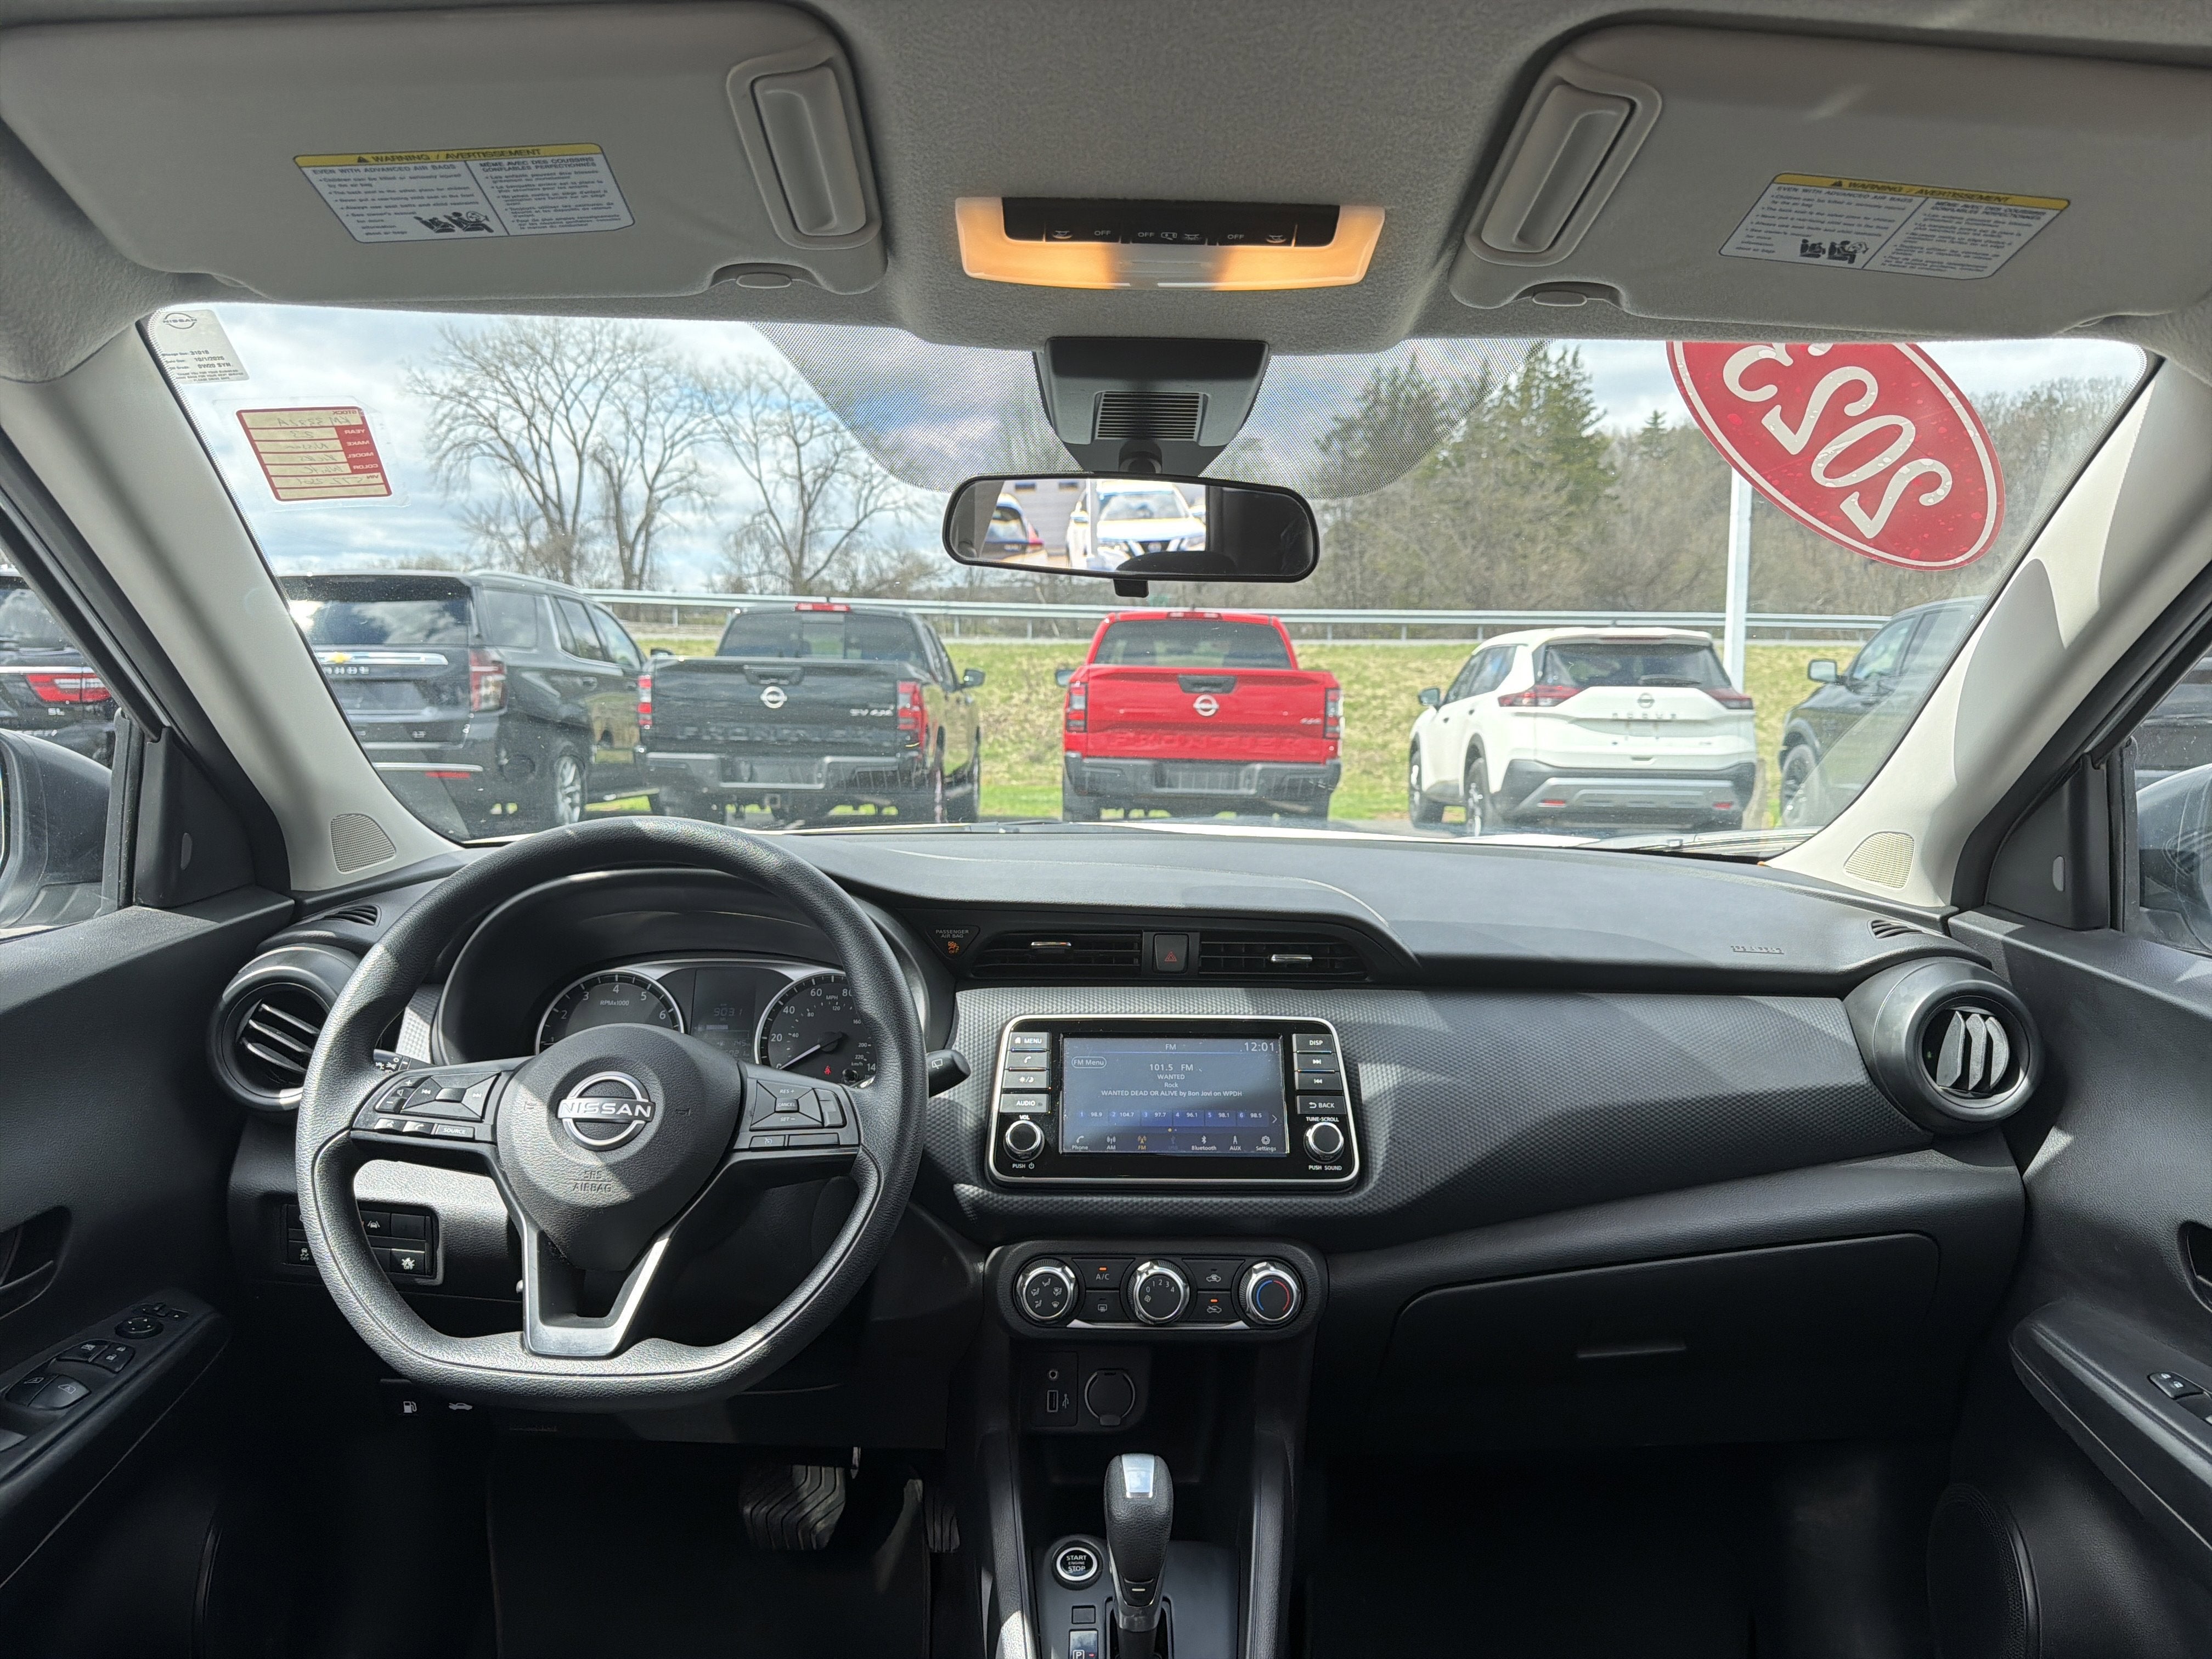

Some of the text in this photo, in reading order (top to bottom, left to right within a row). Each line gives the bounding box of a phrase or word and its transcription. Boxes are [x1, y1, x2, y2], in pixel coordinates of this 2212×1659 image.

[371, 151, 431, 162] WARNING
[445, 149, 541, 160] AVERTISSEMENT
[612, 984, 619, 994] 4
[810, 988, 822, 997] 60
[583, 991, 589, 1001] 3
[641, 991, 647, 1001] 5
[561, 1010, 567, 1019] 2
[659, 1010, 666, 1020] 6
[782, 1006, 795, 1014] 40
[771, 1033, 783, 1042] 20
[1244, 1042, 1274, 1052] 12:01
[561, 1102, 652, 1118] NISSAN
[572, 1182, 612, 1193] AIRBAG
